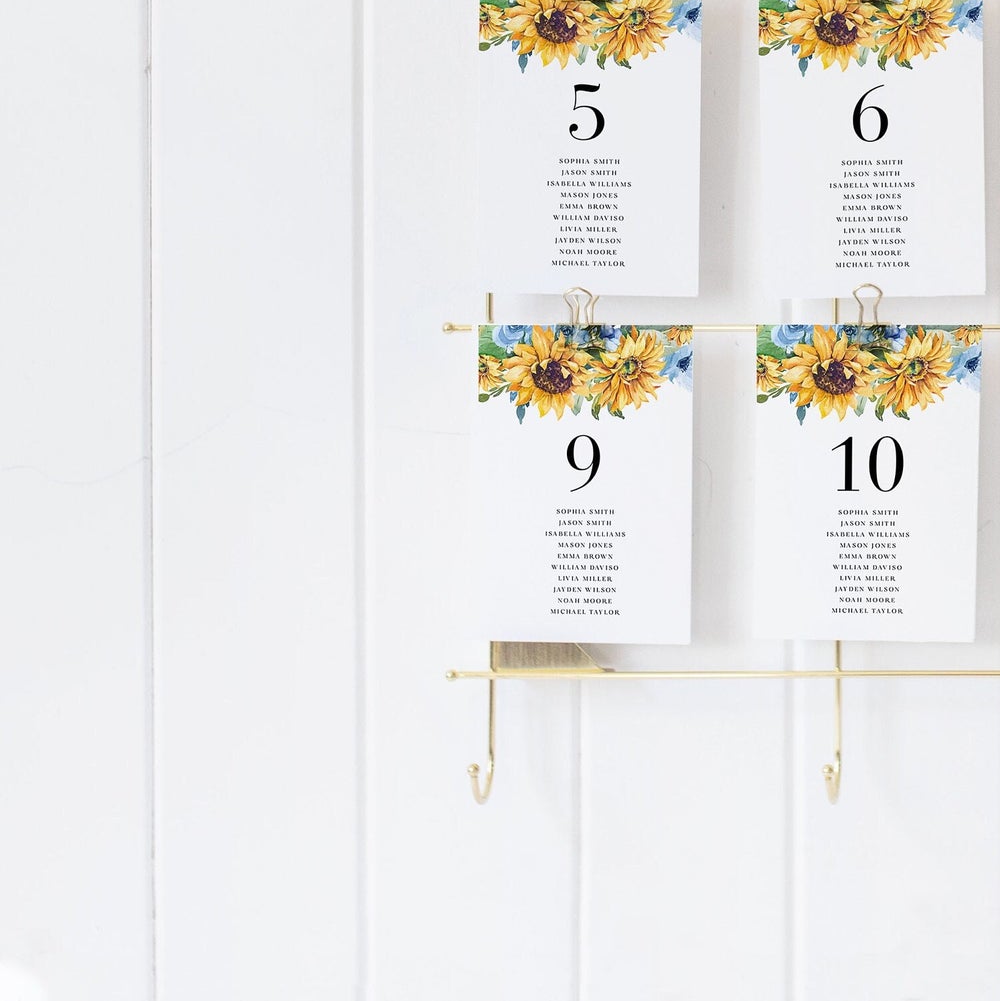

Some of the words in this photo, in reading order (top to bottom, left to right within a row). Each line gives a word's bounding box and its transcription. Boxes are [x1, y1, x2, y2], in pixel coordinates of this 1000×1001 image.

[568, 83, 606, 141] 5
[852, 84, 889, 143] 6
[558, 157, 590, 165] SOPHIA
[843, 170, 870, 179] JASON
[589, 180, 632, 188] WILLIAMS
[872, 181, 916, 189] WILLIAMS
[875, 192, 902, 201] JONES
[560, 225, 582, 233] LIVIA
[838, 238, 869, 247] JAYDEN
[586, 248, 617, 256] MOORE
[835, 261, 874, 269] MICHAEL
[566, 434, 601, 493] 9
[831, 435, 904, 493] 10
[558, 519, 583, 527] JASON
[586, 519, 612, 527] SMITH
[585, 530, 626, 538] WILLIAMS
[588, 542, 613, 550] JONES
[553, 586, 582, 594] JAYDEN
